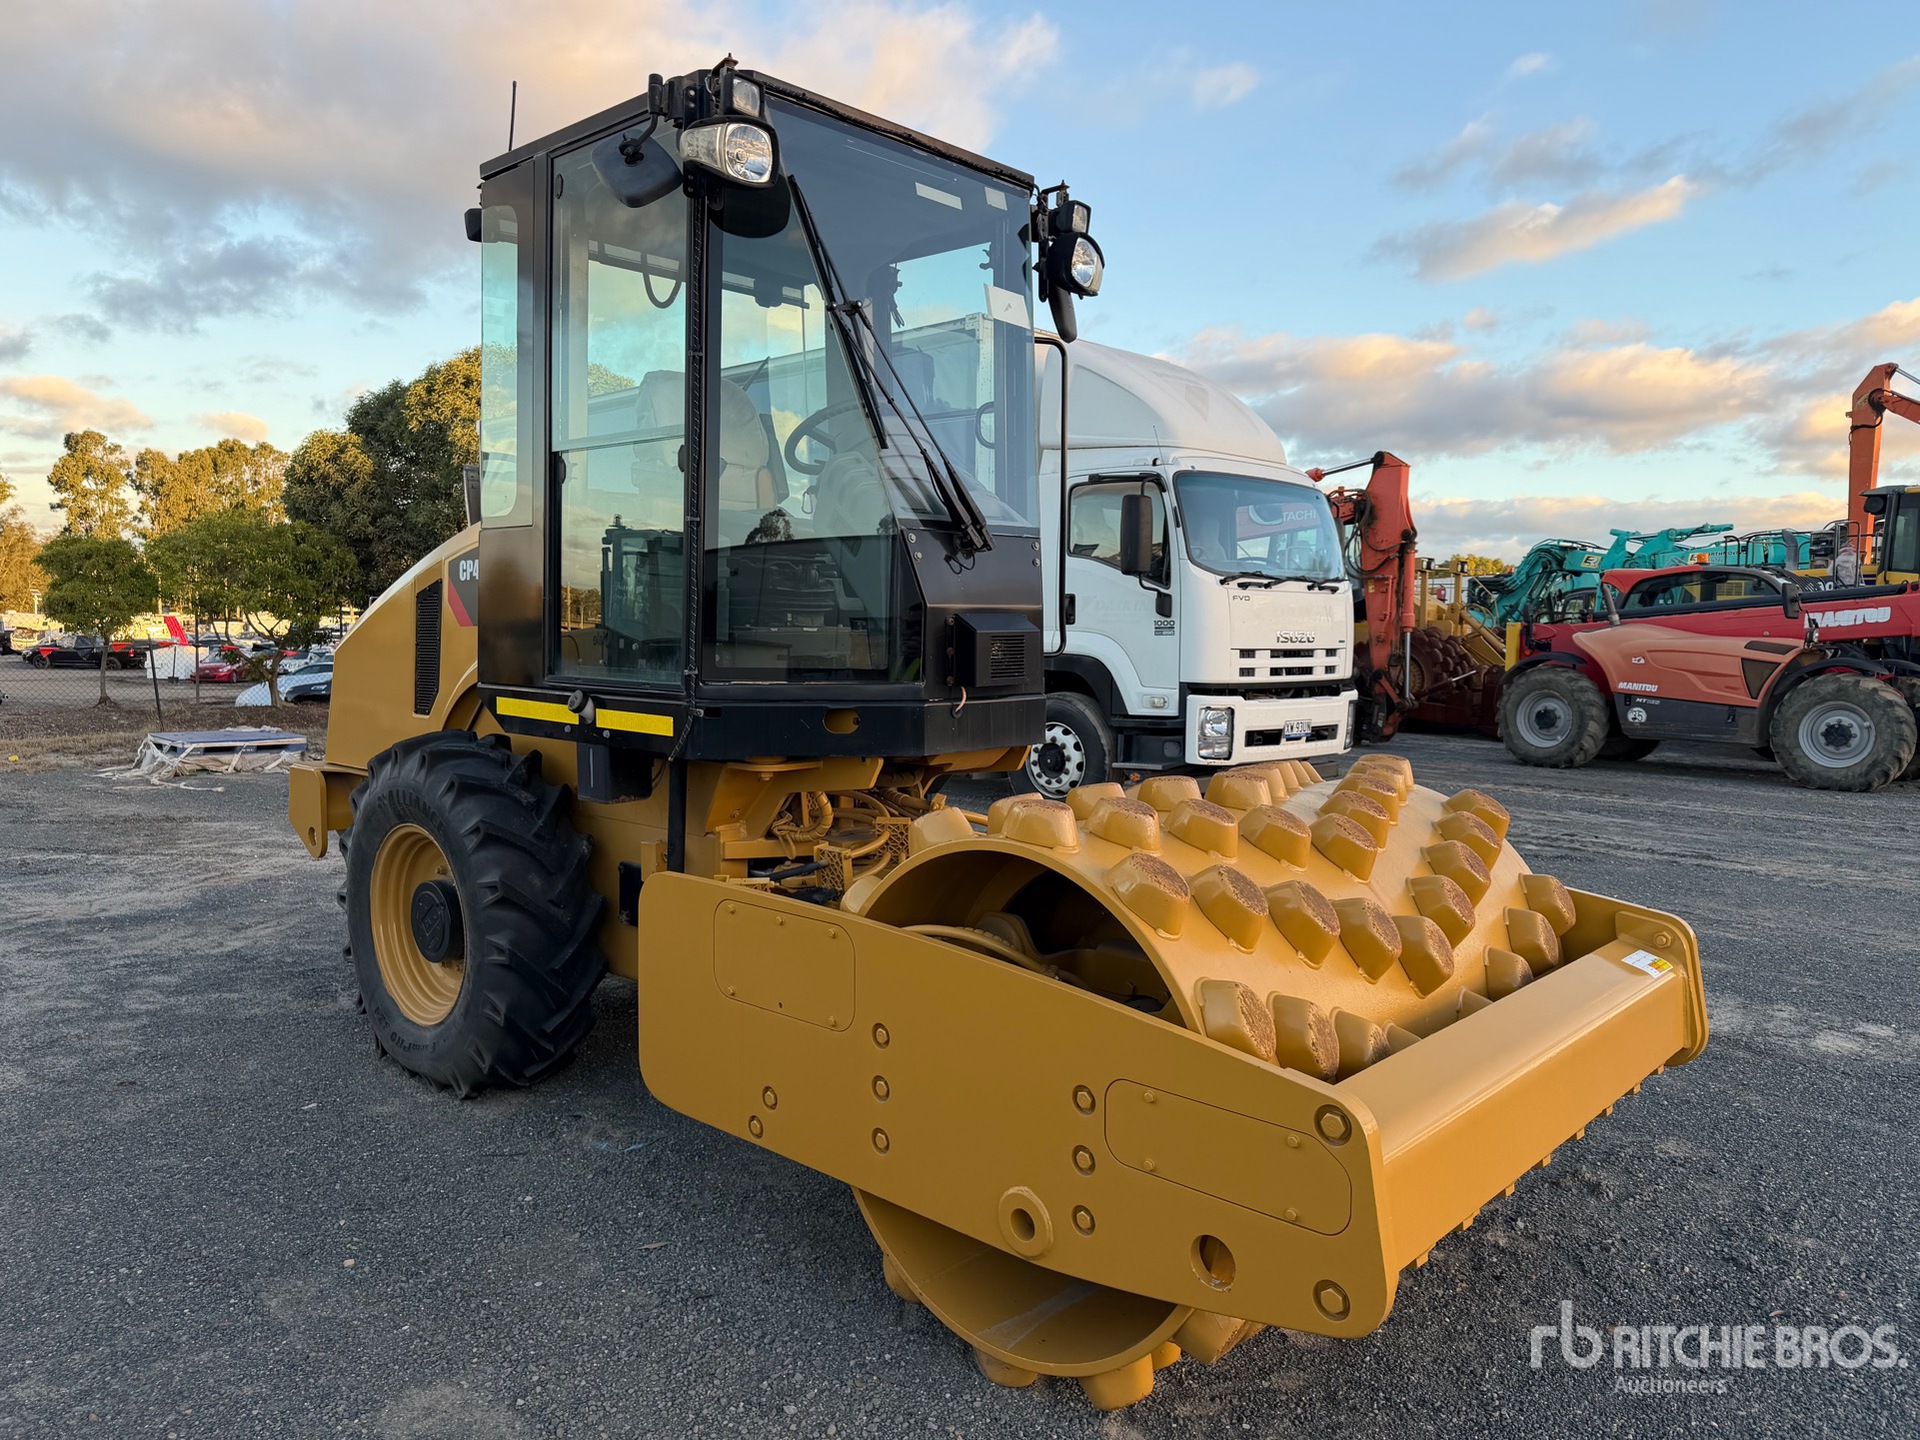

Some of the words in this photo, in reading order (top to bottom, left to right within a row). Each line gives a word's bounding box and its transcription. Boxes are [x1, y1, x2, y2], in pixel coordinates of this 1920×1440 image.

[459, 559, 479, 581] CP4
[1276, 631, 1315, 643] ISUZU
[1618, 681, 1659, 692] MANITOU
[387, 787, 448, 836] ALLIANCE
